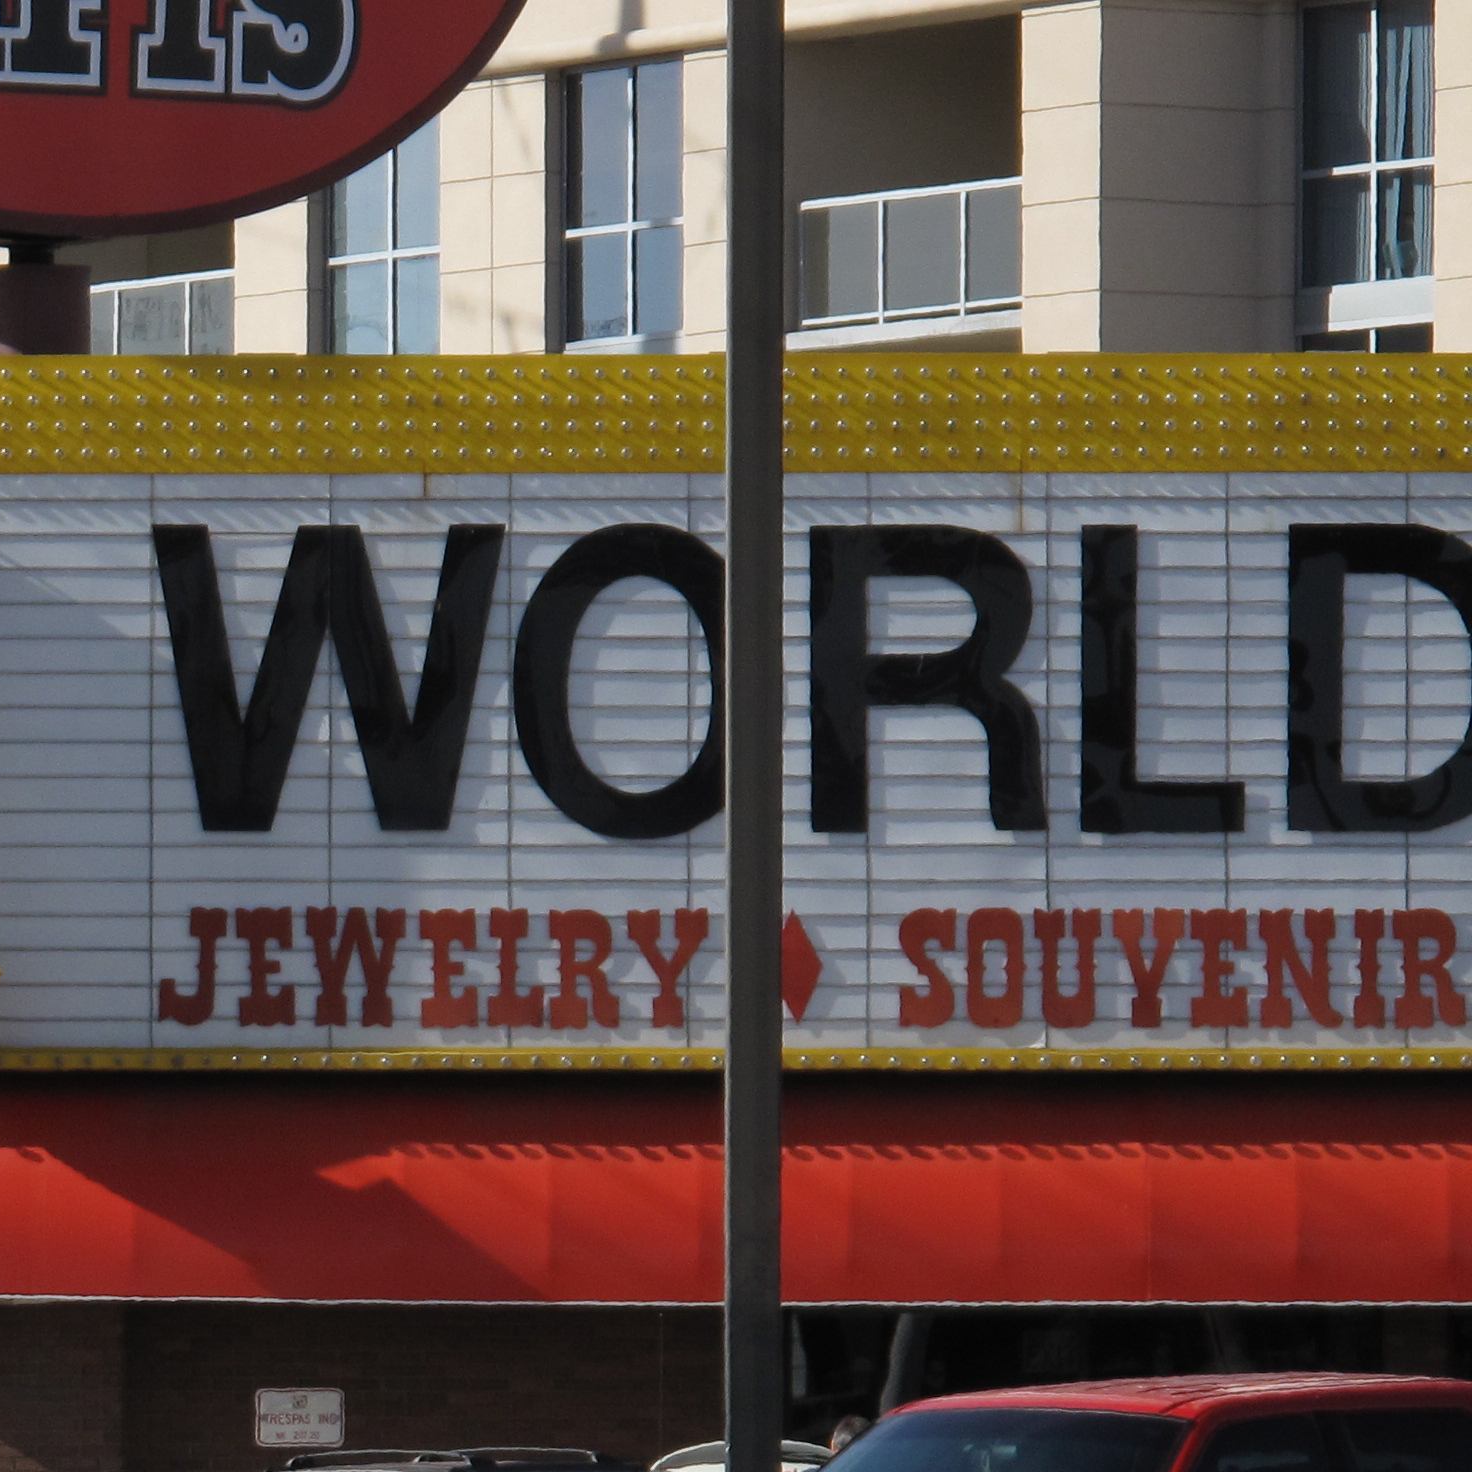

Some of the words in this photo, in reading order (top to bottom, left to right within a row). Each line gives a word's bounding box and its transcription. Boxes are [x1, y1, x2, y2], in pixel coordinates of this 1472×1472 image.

[151, 523, 1472, 838] WORLD
[159, 906, 710, 1027] JEWELRY
[898, 903, 1468, 1028] SOUVENIR
